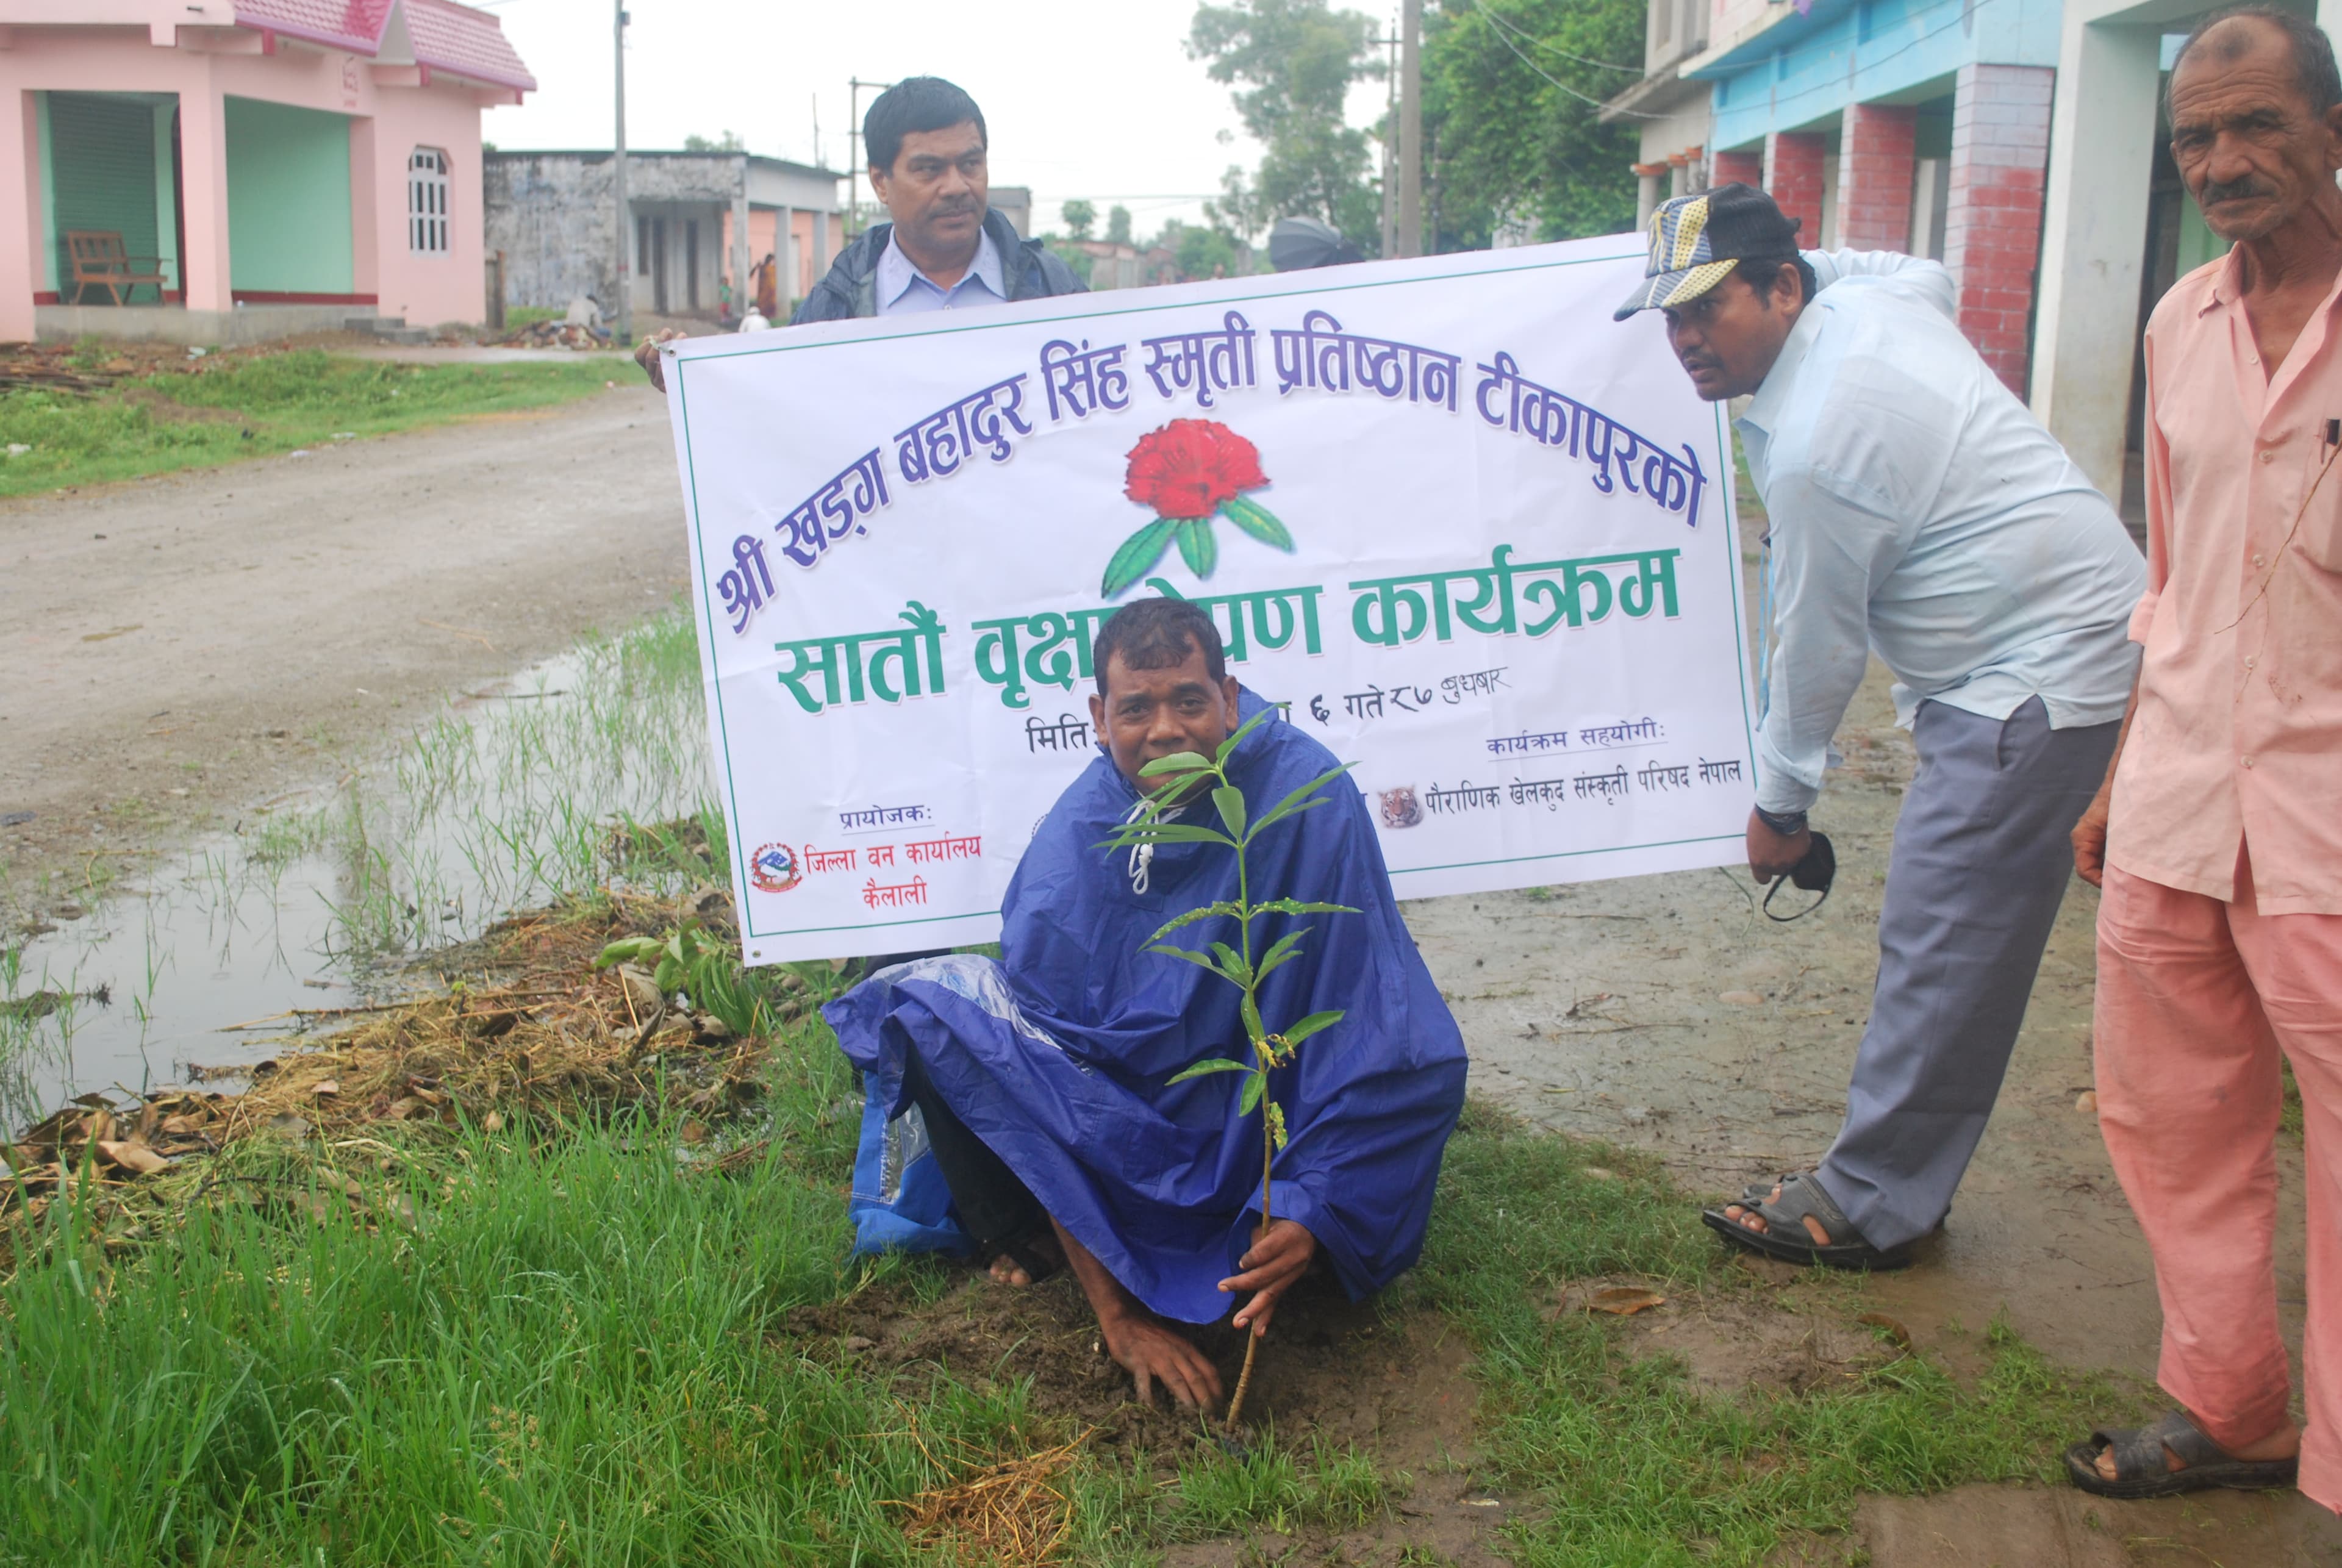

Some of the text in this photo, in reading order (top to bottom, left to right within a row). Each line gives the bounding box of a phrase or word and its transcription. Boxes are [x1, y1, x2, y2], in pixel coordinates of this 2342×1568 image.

[716, 534, 775, 634] श्री
[893, 372, 1033, 462] बहादुर
[1040, 338, 1129, 421] सिंह
[1141, 310, 1256, 407] स्मृती
[1270, 310, 1462, 412] प्रतिष्ठान
[1475, 351, 1708, 528] टीकापुरको
[1348, 543, 1681, 646] कार्यक्रम
[1343, 684, 1385, 720] गते
[1486, 729, 1567, 755] कार्यक्रम
[1425, 757, 1741, 814] पौराणिक खेलकुद संस्कृती परिषद नेपाल
[803, 831, 981, 874] जिल्ला वन कार्यालय
[862, 875, 927, 909] कैलाली
